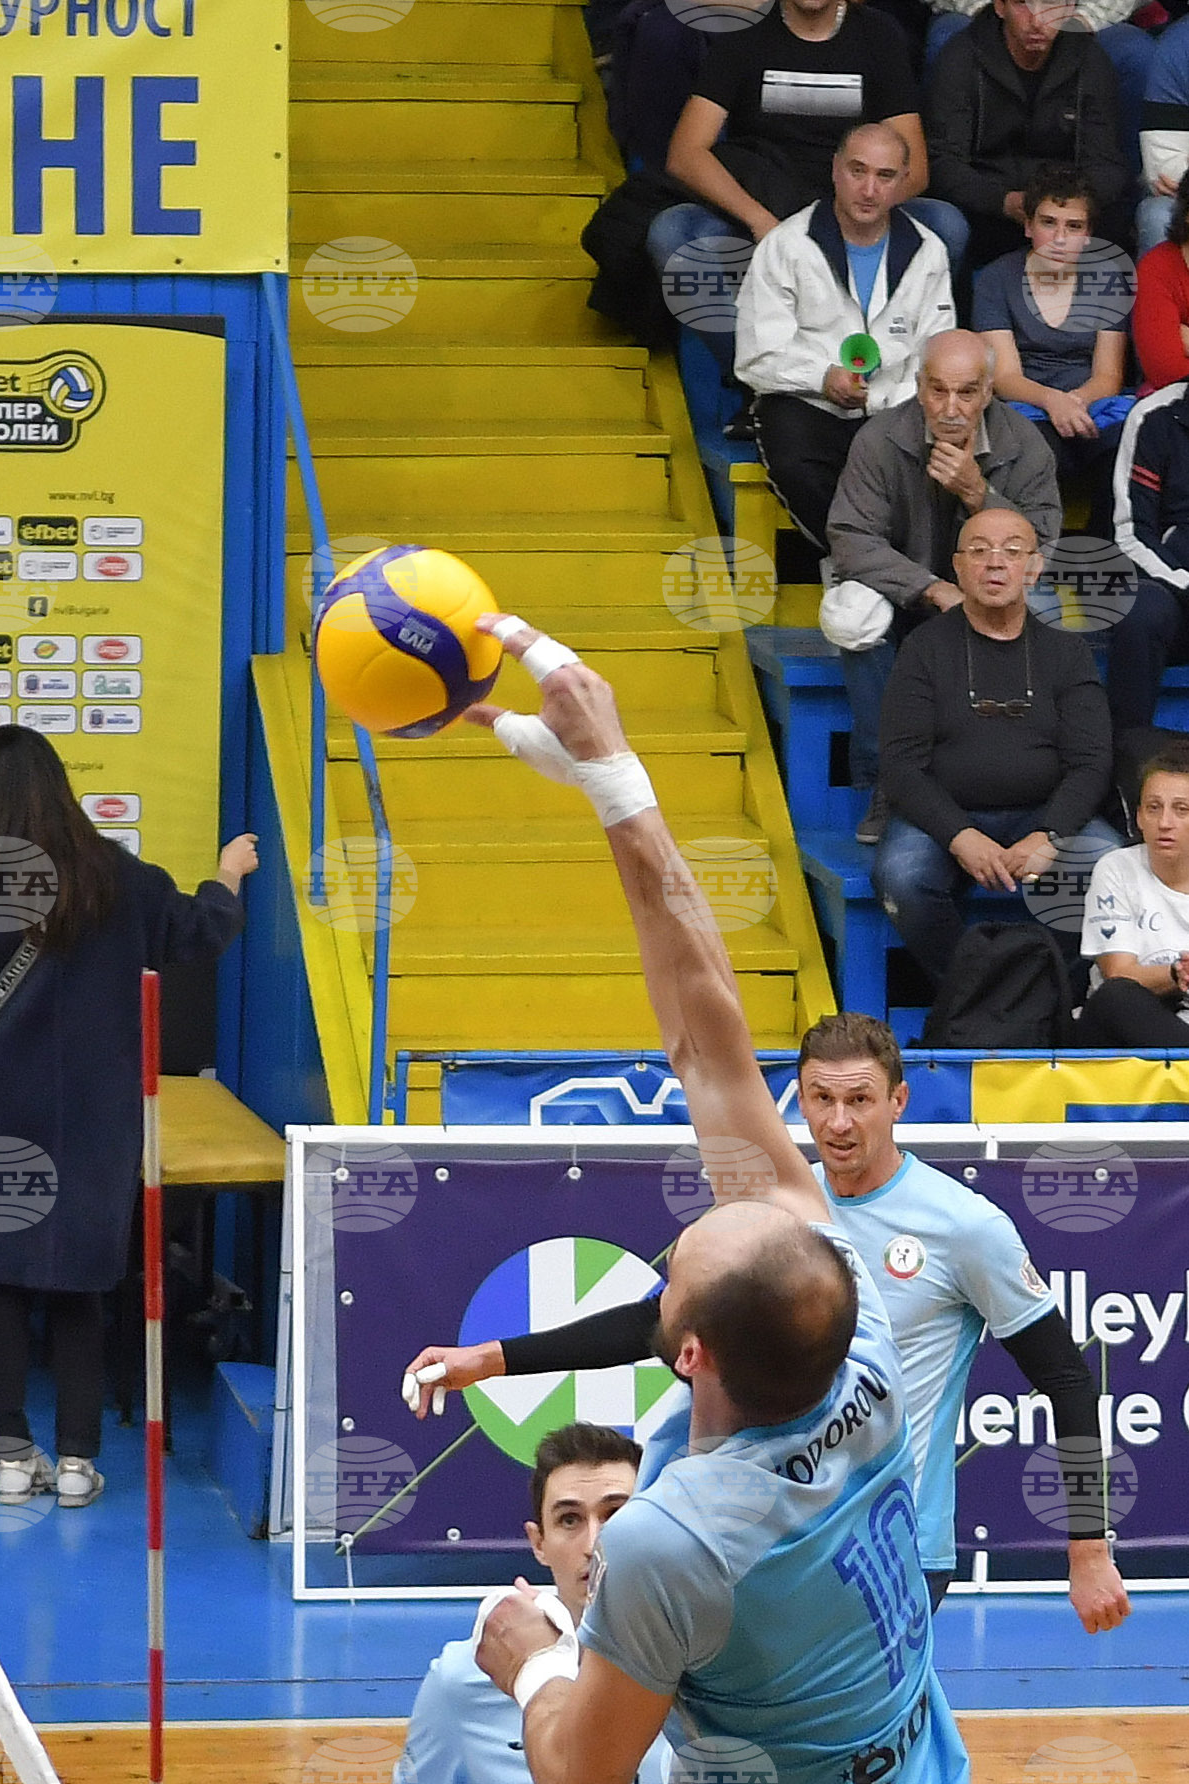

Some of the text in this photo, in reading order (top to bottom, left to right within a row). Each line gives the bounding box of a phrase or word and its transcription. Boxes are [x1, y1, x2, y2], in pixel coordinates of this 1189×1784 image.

[21, 522, 78, 541] efbet
[775, 1365, 888, 1484] ODOROV
[830, 1478, 924, 1692] 10
